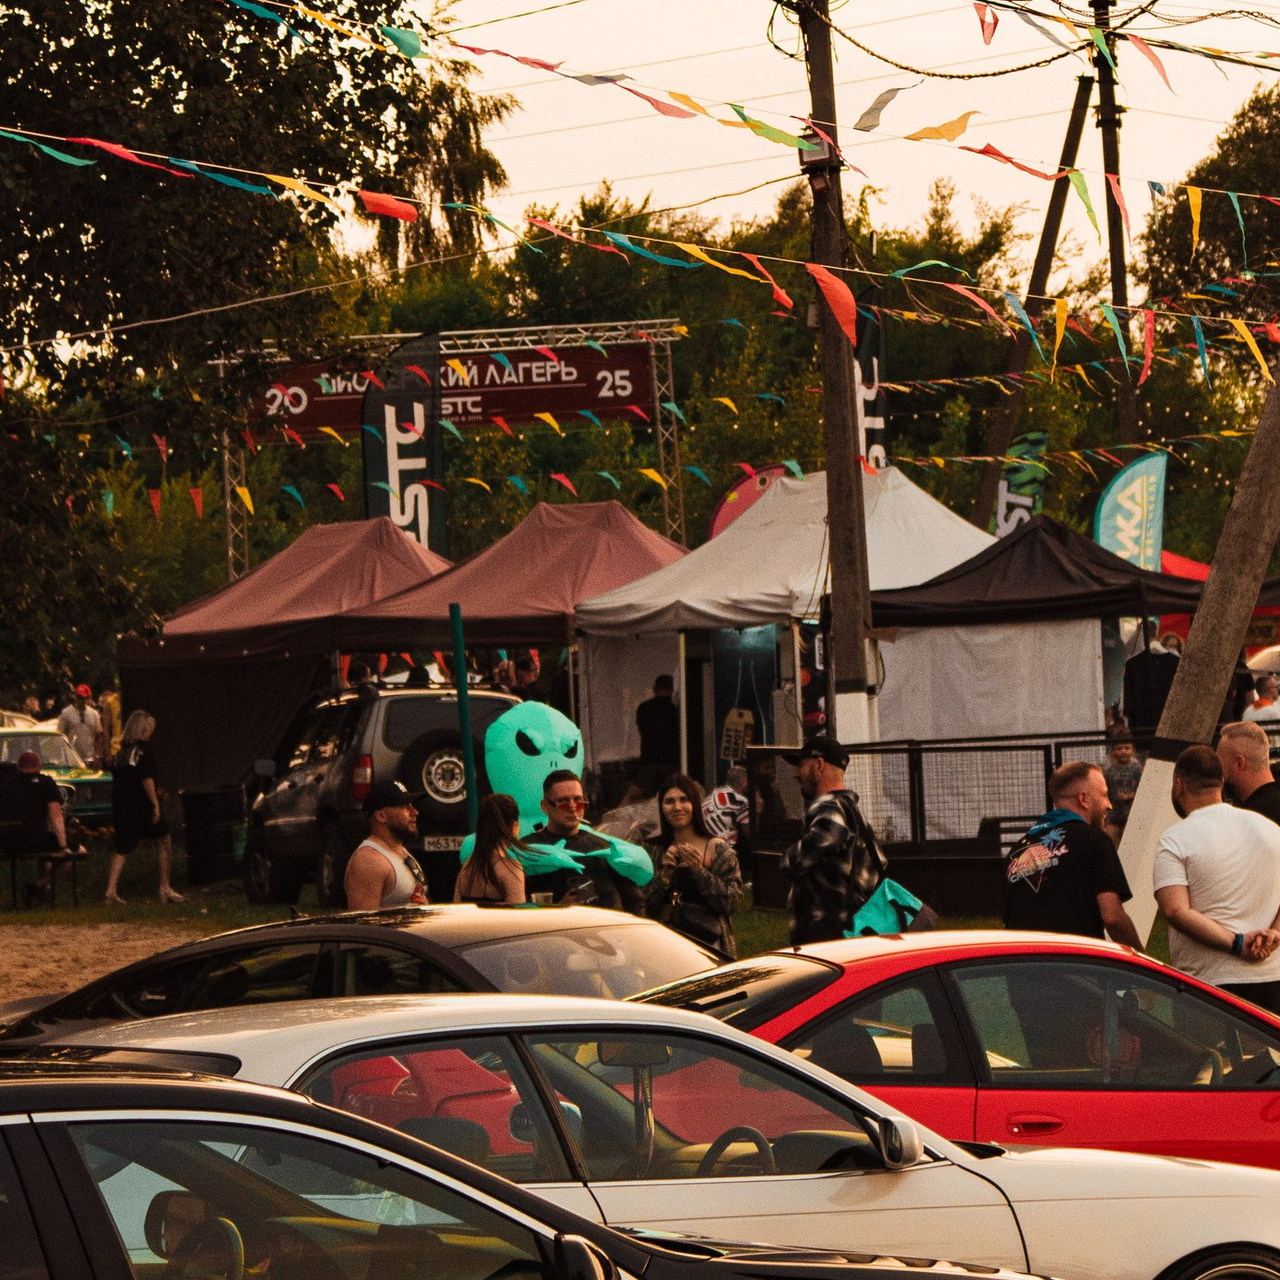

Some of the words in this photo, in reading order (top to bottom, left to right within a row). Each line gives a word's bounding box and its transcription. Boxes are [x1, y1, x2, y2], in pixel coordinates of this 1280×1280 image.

[489, 360, 578, 385] ЛАГЕРЬ
[596, 369, 633, 398] 25
[265, 387, 308, 416] 20
